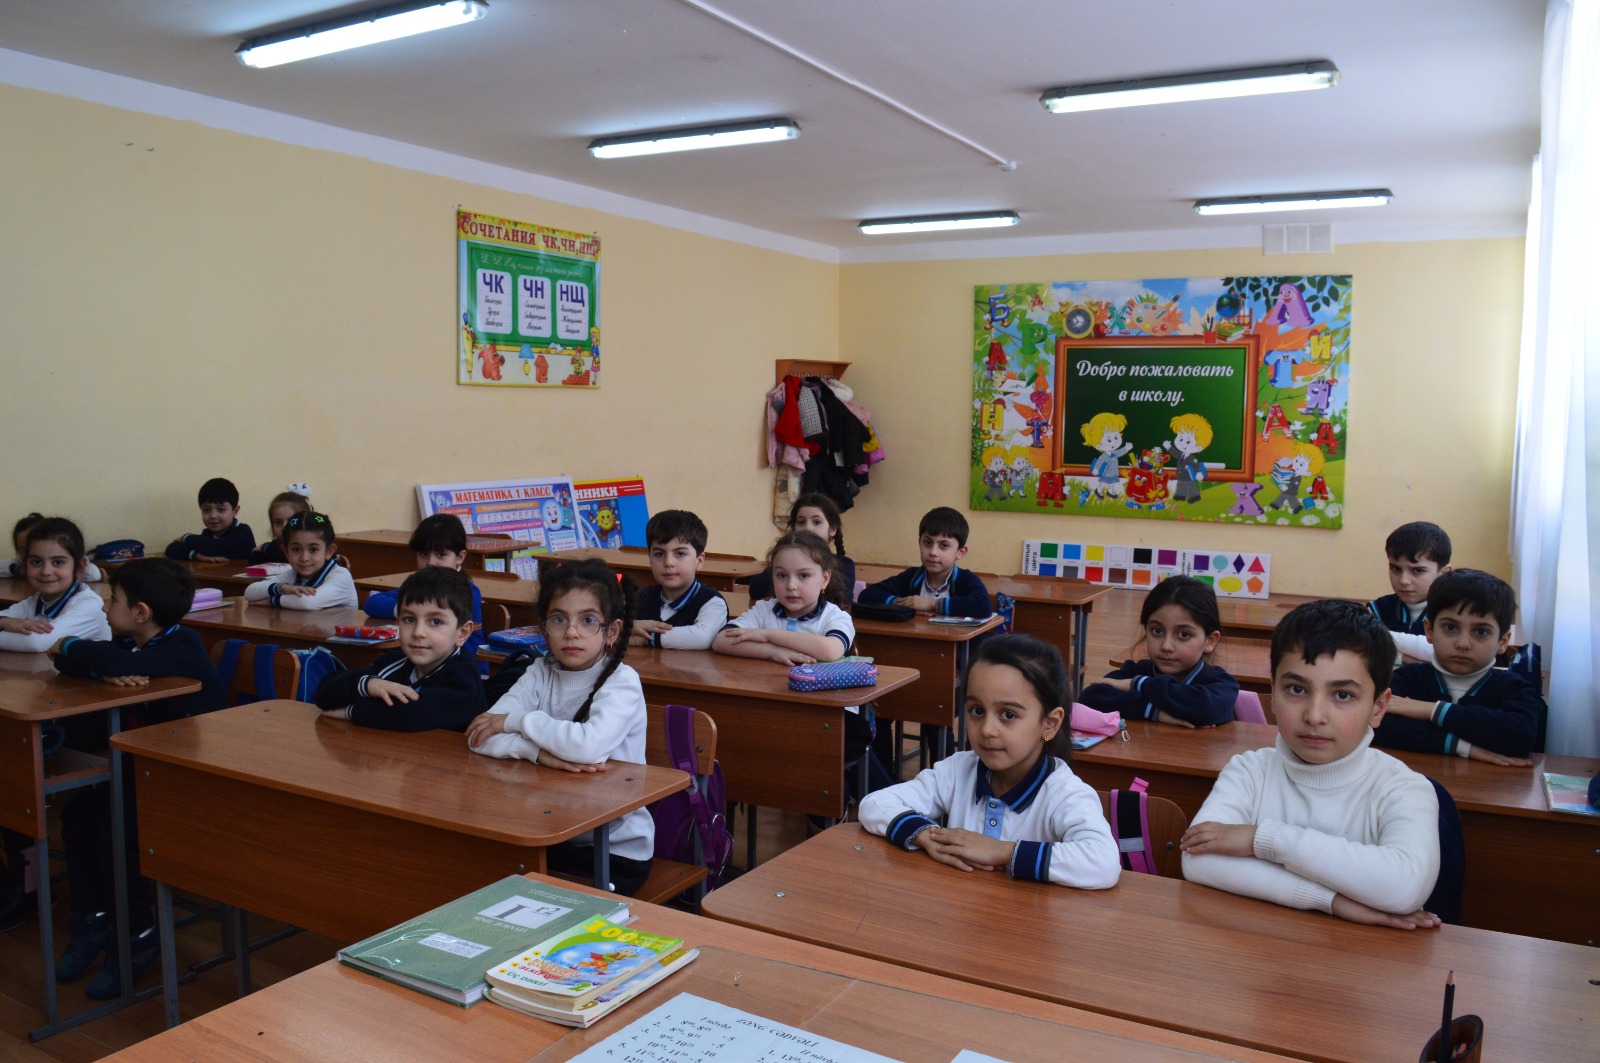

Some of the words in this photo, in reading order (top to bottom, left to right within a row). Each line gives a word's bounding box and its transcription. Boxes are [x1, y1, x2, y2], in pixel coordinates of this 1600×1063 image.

[460, 220, 536, 246] СОЧЕТАНИЯ
[482, 272, 504, 294] ЧК
[523, 278, 544, 300] ЧН
[560, 283, 585, 307] НЩ
[1076, 360, 1127, 381] Добро
[1129, 364, 1234, 377] пожаловать
[1118, 390, 1127, 401] в
[1130, 389, 1185, 407] школу.
[516, 488, 520, 498] 1
[523, 486, 551, 498] КЛАСС
[583, 919, 638, 943] 100
[567, 982, 592, 992] 2
[736, 1019, 768, 1031] ZƏNG
[769, 1028, 820, 1048] CƏDVƏLİ
